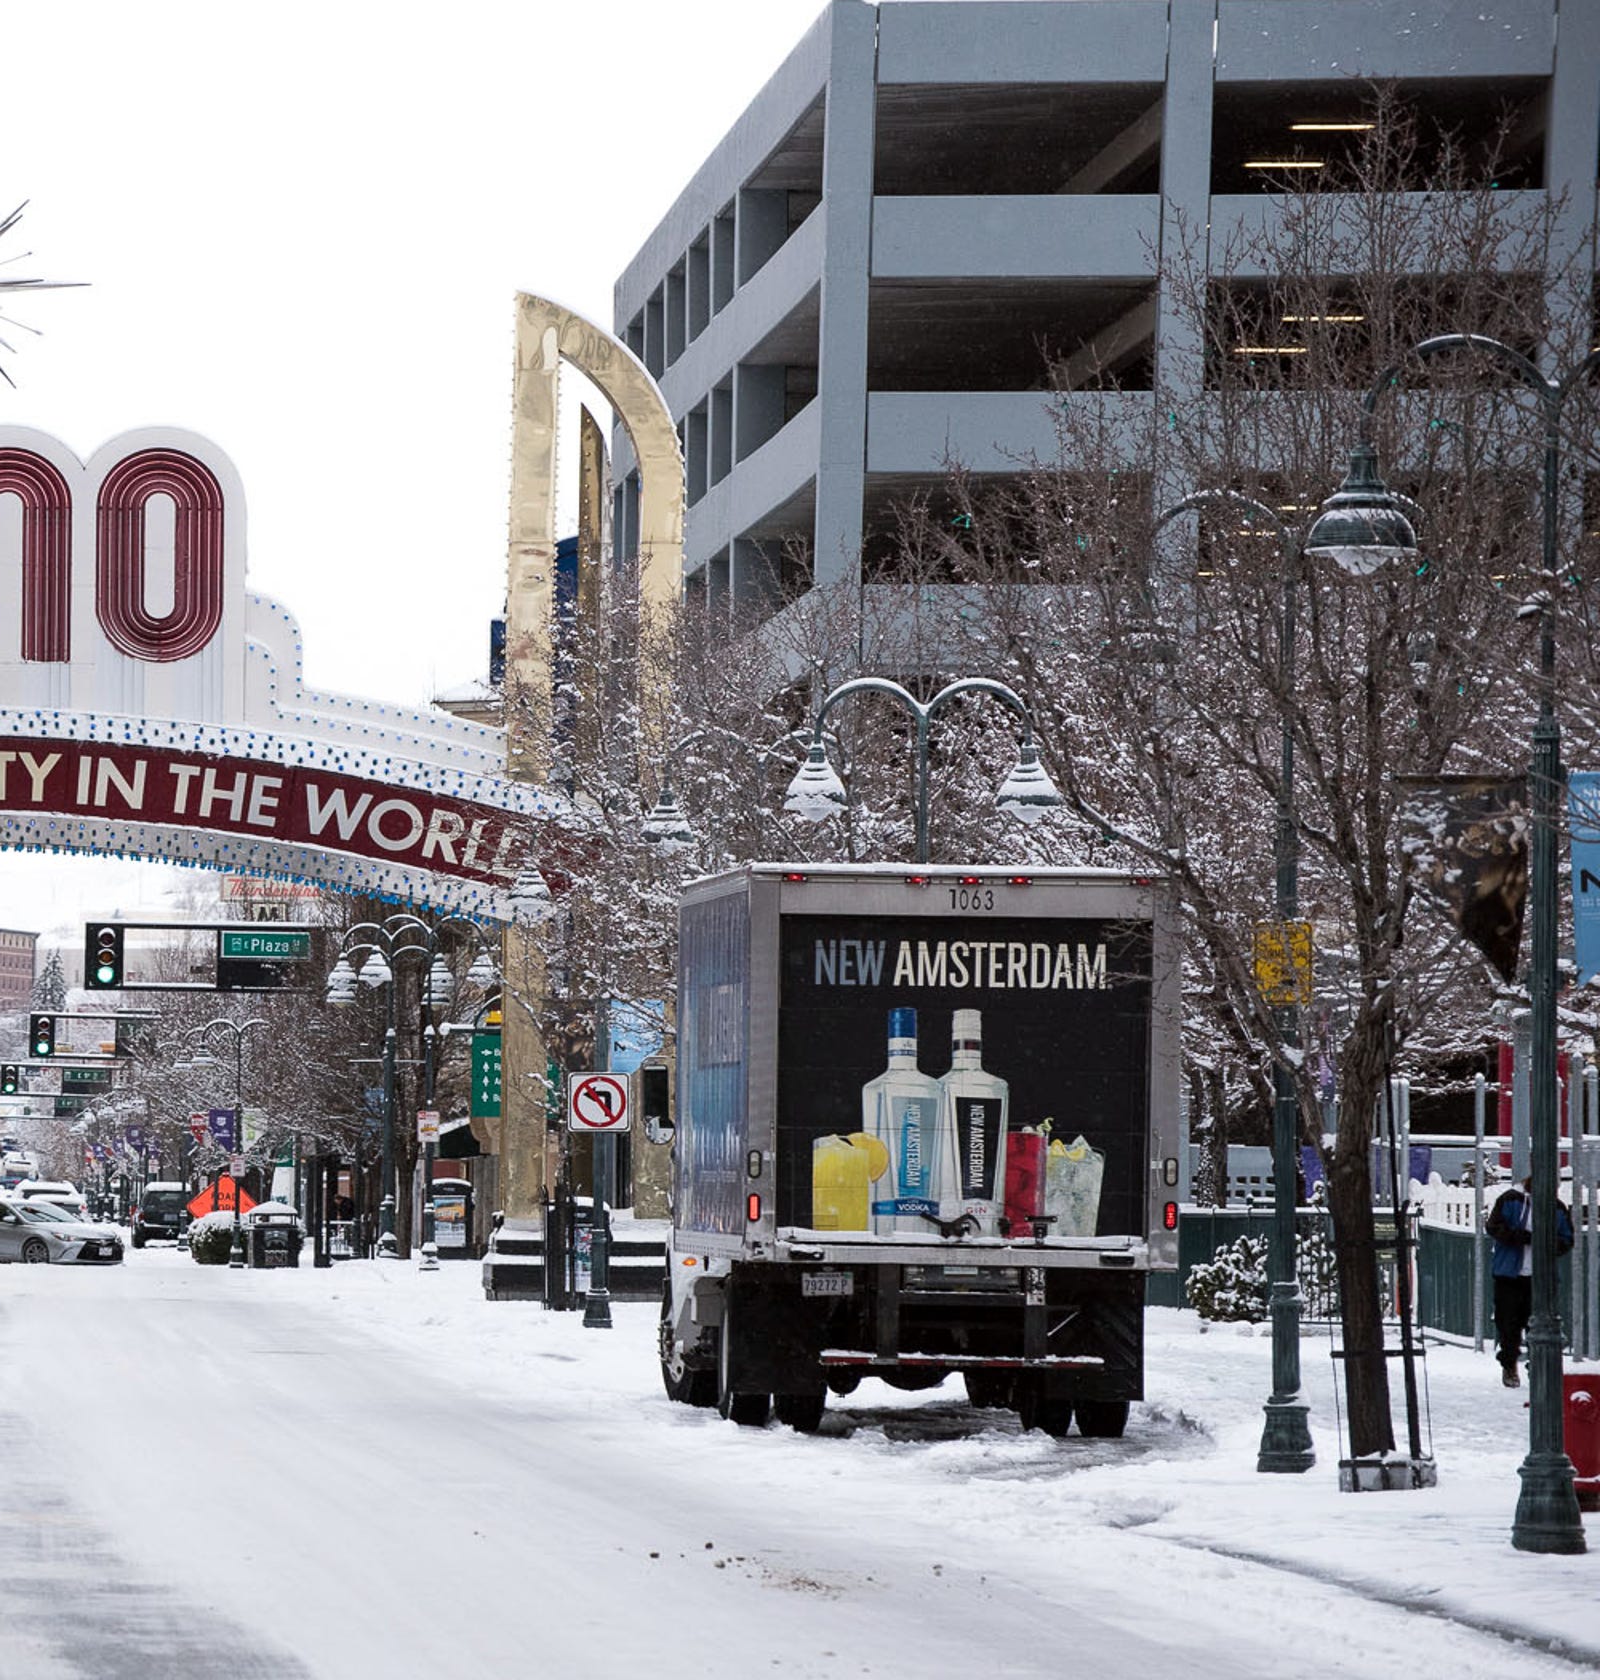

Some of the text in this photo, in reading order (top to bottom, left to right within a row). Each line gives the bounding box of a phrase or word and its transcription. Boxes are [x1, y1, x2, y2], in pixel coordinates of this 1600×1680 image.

[76, 756, 147, 810] IN
[169, 762, 283, 828] THE
[950, 889, 994, 911] 1063
[250, 938, 289, 952] Plaza
[815, 940, 1108, 990] NEW AMSTERDAM
[906, 1104, 921, 1187] NEW AMSTERDAM
[969, 1105, 985, 1188] NEW AMSTERDAM
[211, 1192, 236, 1201] OA
[898, 1203, 930, 1212] VODKA
[966, 1206, 988, 1214] GIN
